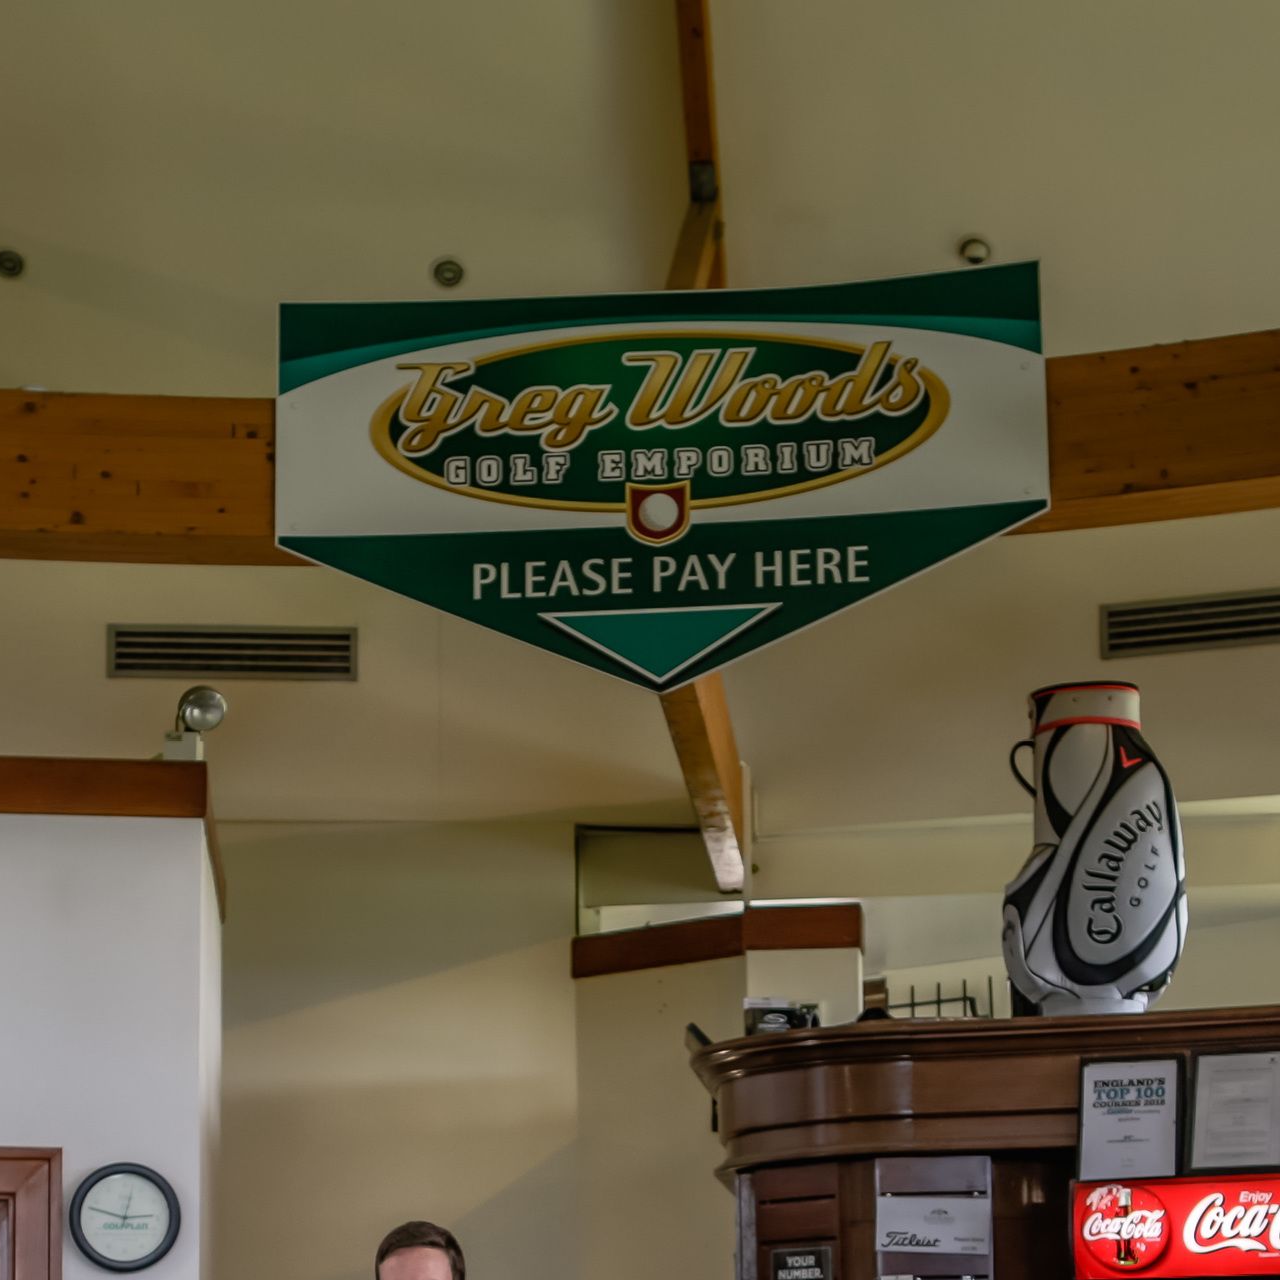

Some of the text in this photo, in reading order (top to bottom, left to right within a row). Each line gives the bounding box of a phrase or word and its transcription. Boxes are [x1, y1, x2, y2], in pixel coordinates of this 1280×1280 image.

[396, 341, 924, 456] Greg Woods
[444, 437, 877, 486] GOLF EMPORIUM
[472, 546, 871, 600] PLEASE PAY HERE
[1082, 801, 1164, 944] Callaway
[1129, 846, 1160, 907] GOLF
[1093, 1077, 1166, 1089] ENGLAND'S
[1094, 1087, 1166, 1100] TOP 100
[1239, 1191, 1273, 1205] Enjoy
[1083, 1209, 1166, 1242] Coca-Cola
[881, 1231, 941, 1248] Titleist
[777, 1267, 824, 1280] NUMBER.
[786, 1255, 816, 1267] YOUR
